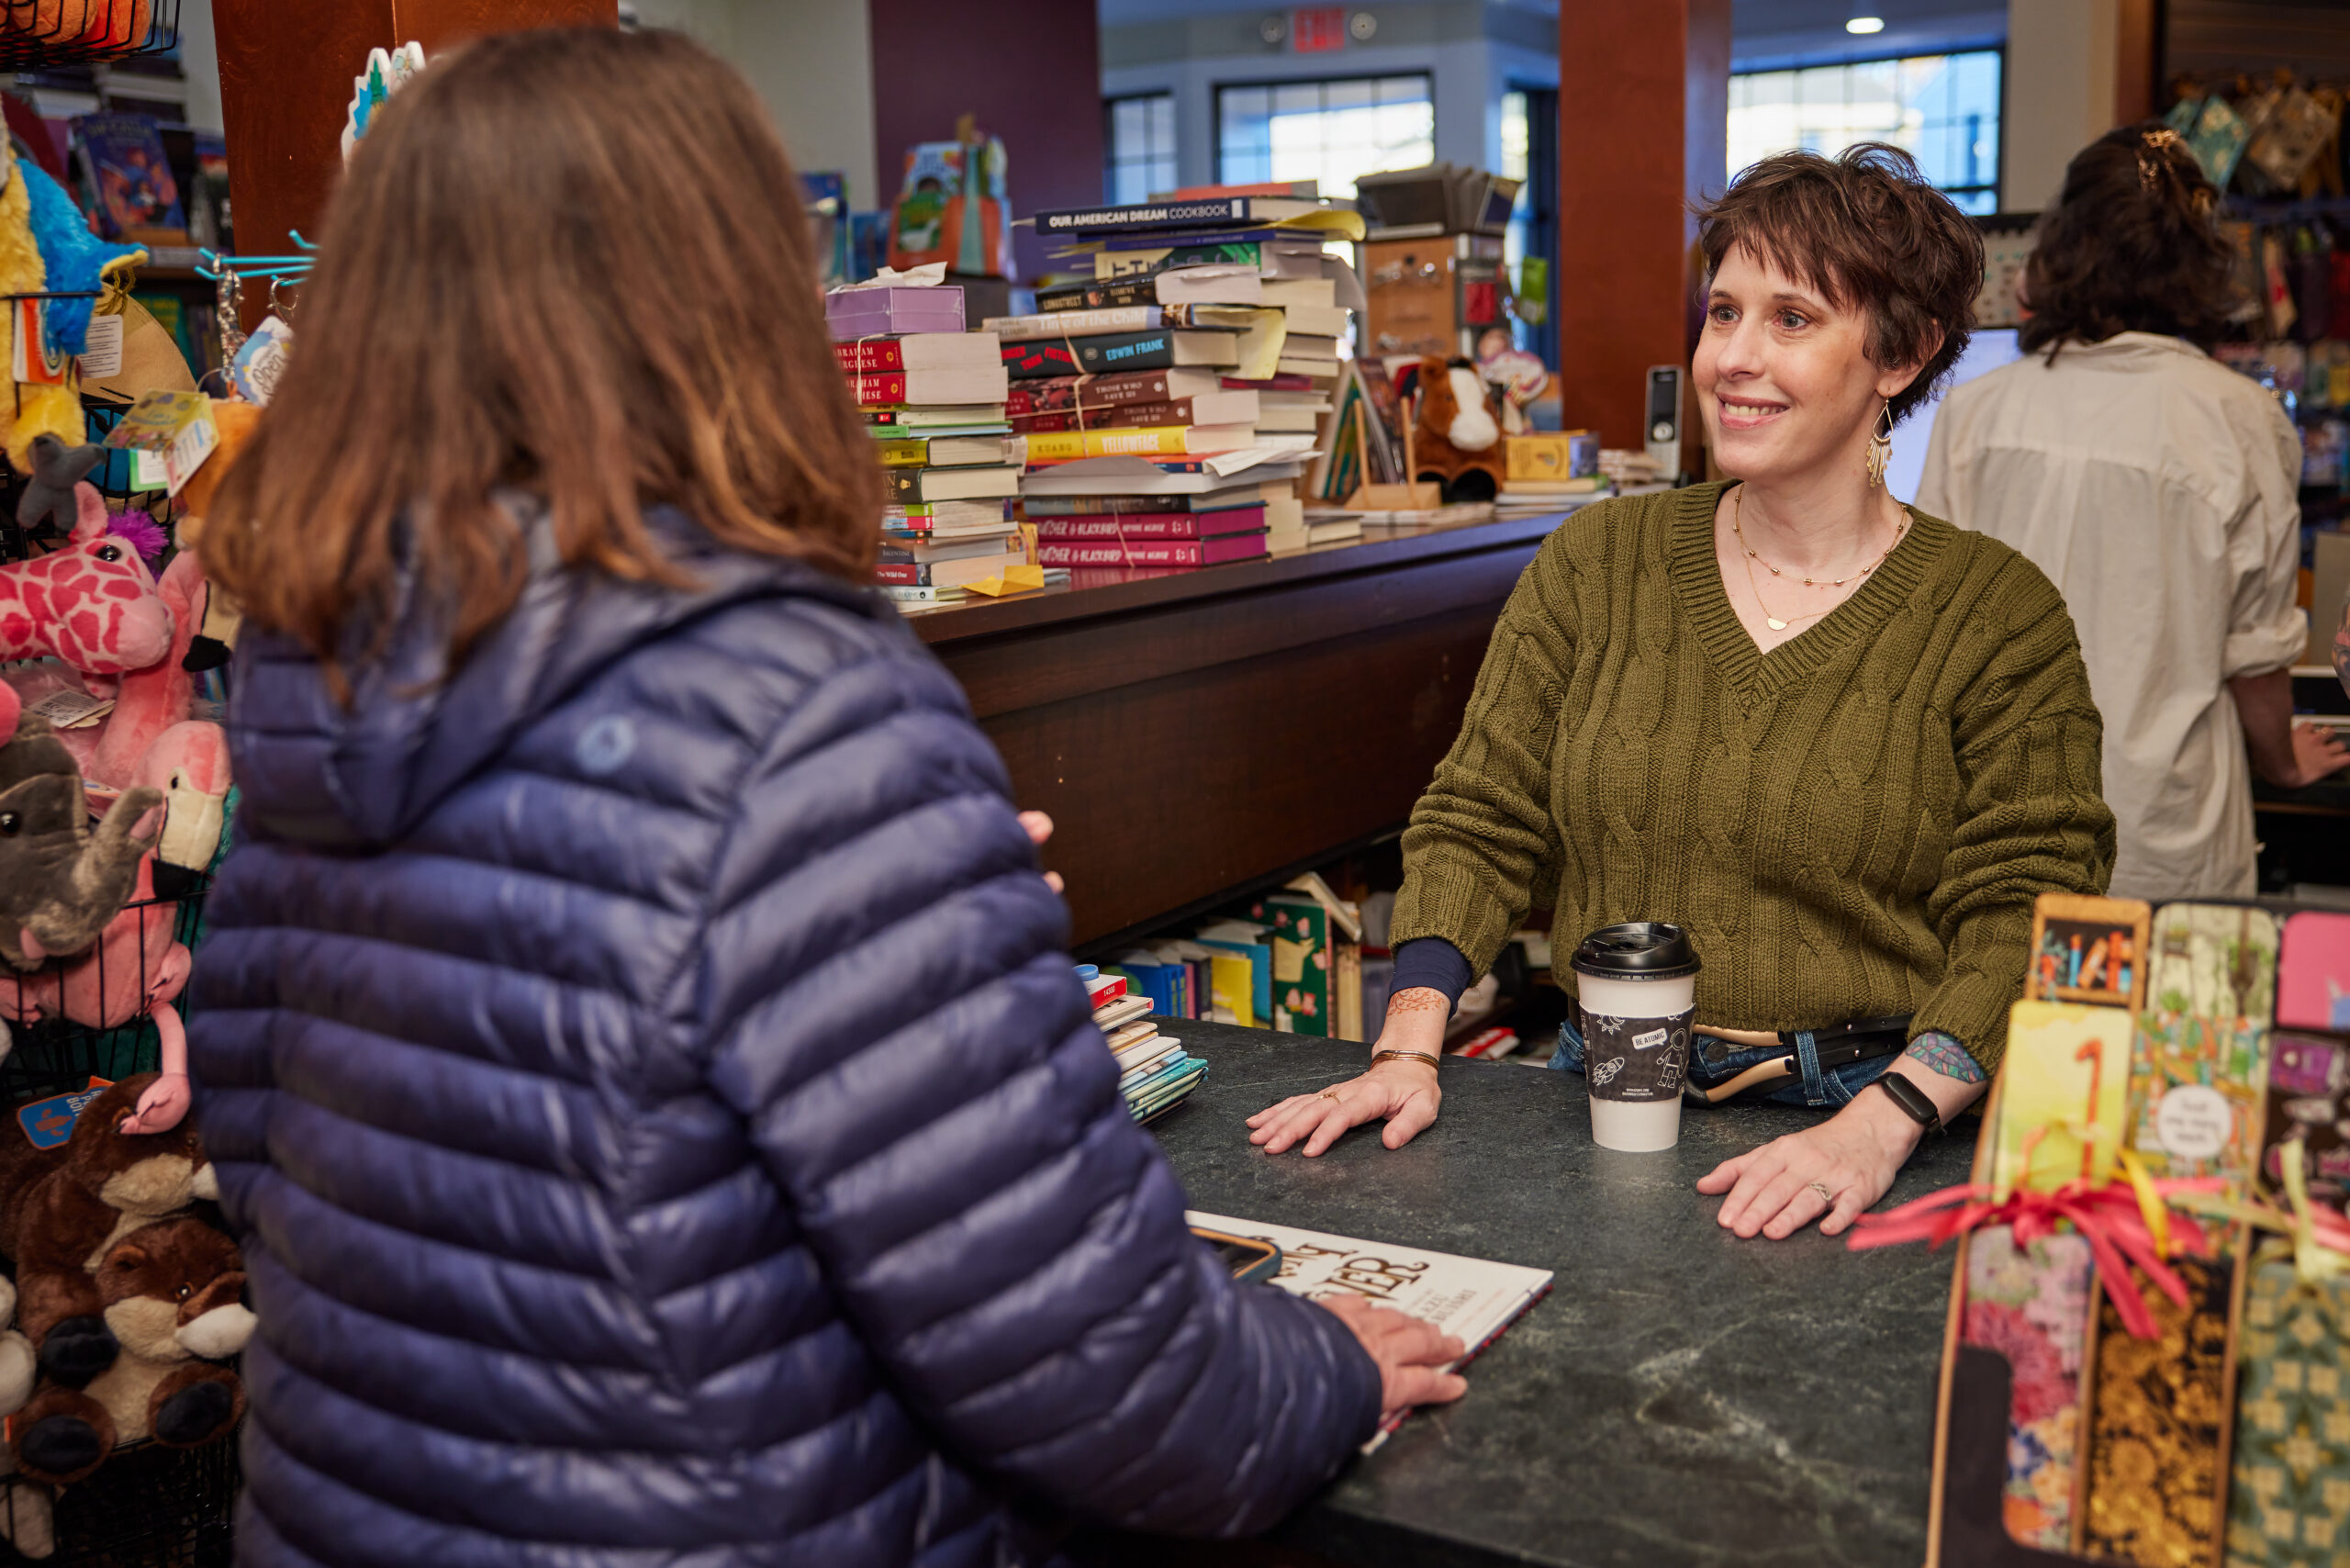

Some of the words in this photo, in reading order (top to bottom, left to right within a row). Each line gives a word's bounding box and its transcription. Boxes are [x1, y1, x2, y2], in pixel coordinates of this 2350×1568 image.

[1049, 214, 1072, 228] OUR
[1073, 210, 1129, 227] AMERICAN
[1129, 207, 1169, 223] DREAM
[1169, 204, 1228, 220] COOKBOOK
[1112, 307, 1147, 326] Child
[1105, 343, 1135, 362] EDWIN
[1136, 338, 1165, 355] FRANK
[1102, 433, 1159, 454] YELLOWFACE
[1635, 1038, 1643, 1047] BE
[1644, 1031, 1665, 1044] ATOMIC
